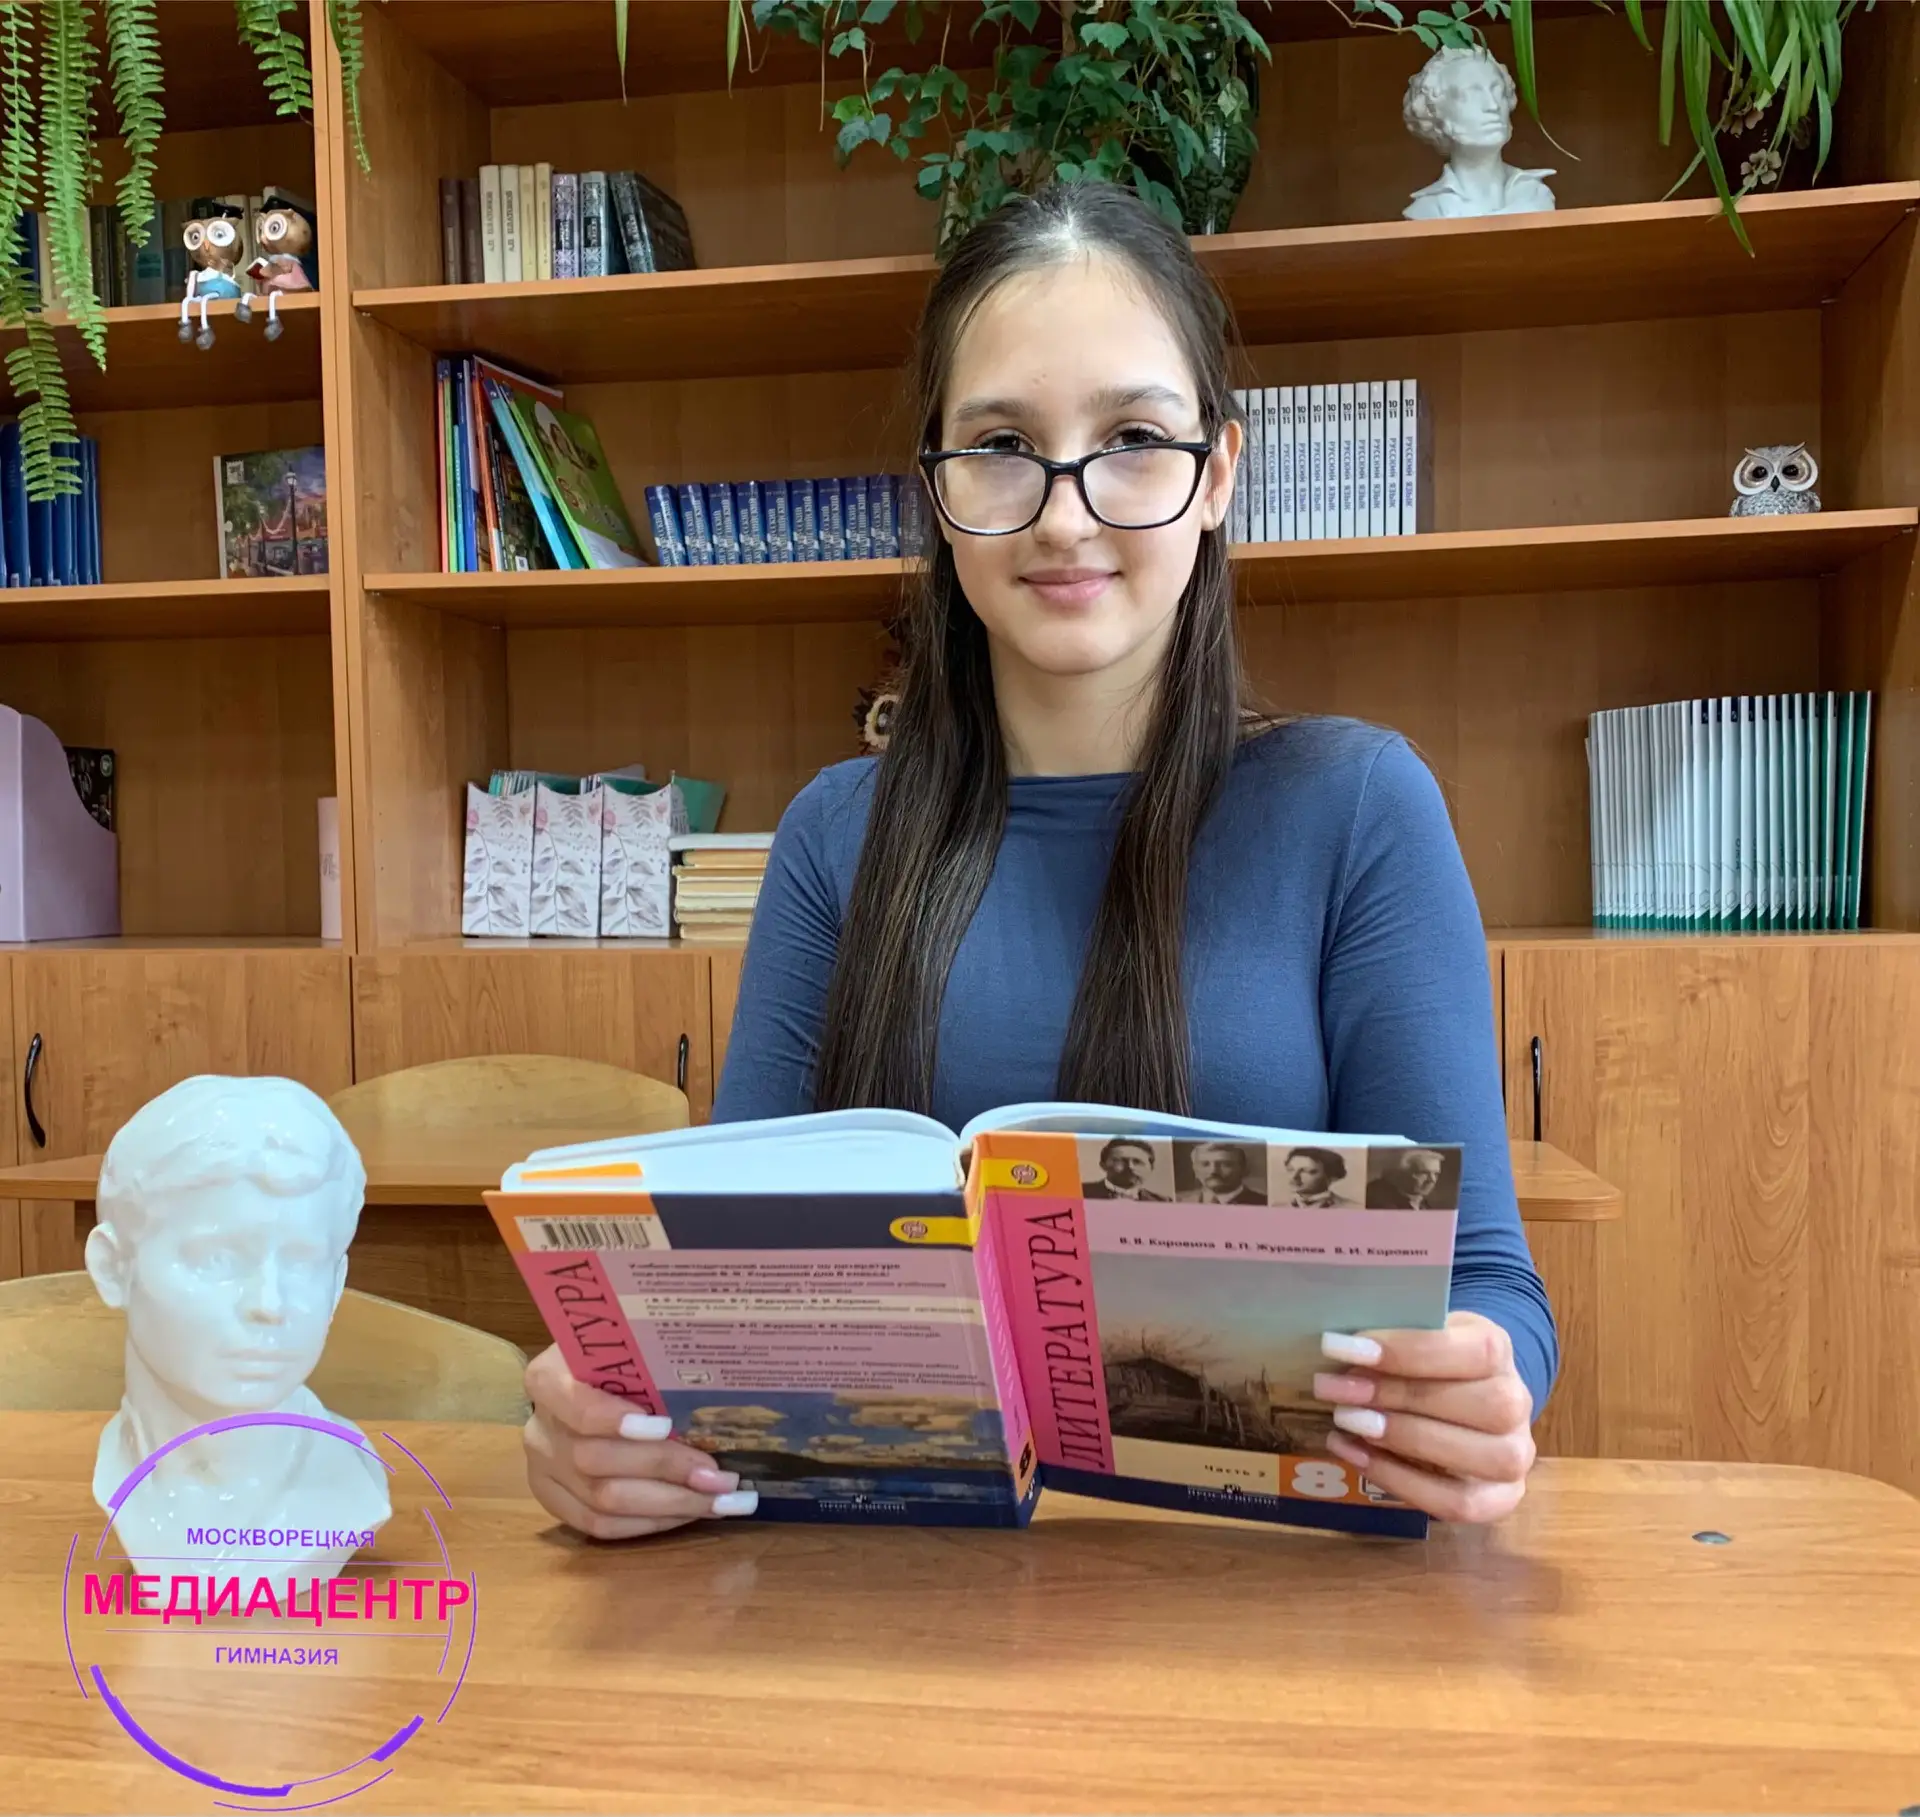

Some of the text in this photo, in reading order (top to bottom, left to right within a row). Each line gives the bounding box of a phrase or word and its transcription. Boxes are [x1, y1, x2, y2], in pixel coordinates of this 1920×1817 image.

[1343, 403, 1352, 411] 10
[1358, 402, 1367, 410] 10
[1372, 401, 1381, 409] 10
[1388, 400, 1397, 408] 10
[1405, 399, 1414, 407] 10
[1267, 407, 1276, 415] 10
[1282, 406, 1291, 414] 10
[1327, 404, 1336, 412] 10
[1343, 413, 1352, 421] 11
[1358, 412, 1366, 420] 11
[1389, 410, 1397, 418] 11
[1406, 409, 1414, 418] 11
[1268, 417, 1276, 425] 11
[1297, 416, 1306, 424] 11
[1313, 415, 1322, 423] 11
[1328, 414, 1336, 422] 11
[1358, 439, 1366, 479] РУССКИЙ
[1389, 438, 1397, 478] РУССКИЙ
[1268, 444, 1276, 484] РУССКИЙ
[1283, 443, 1291, 483] РУССКИЙ
[1149, 1237, 1216, 1249] Коровина
[1024, 1208, 1105, 1468] ЛИТЕРАТУРА
[1205, 1464, 1250, 1476] Часть
[1292, 1461, 1349, 1498] 8
